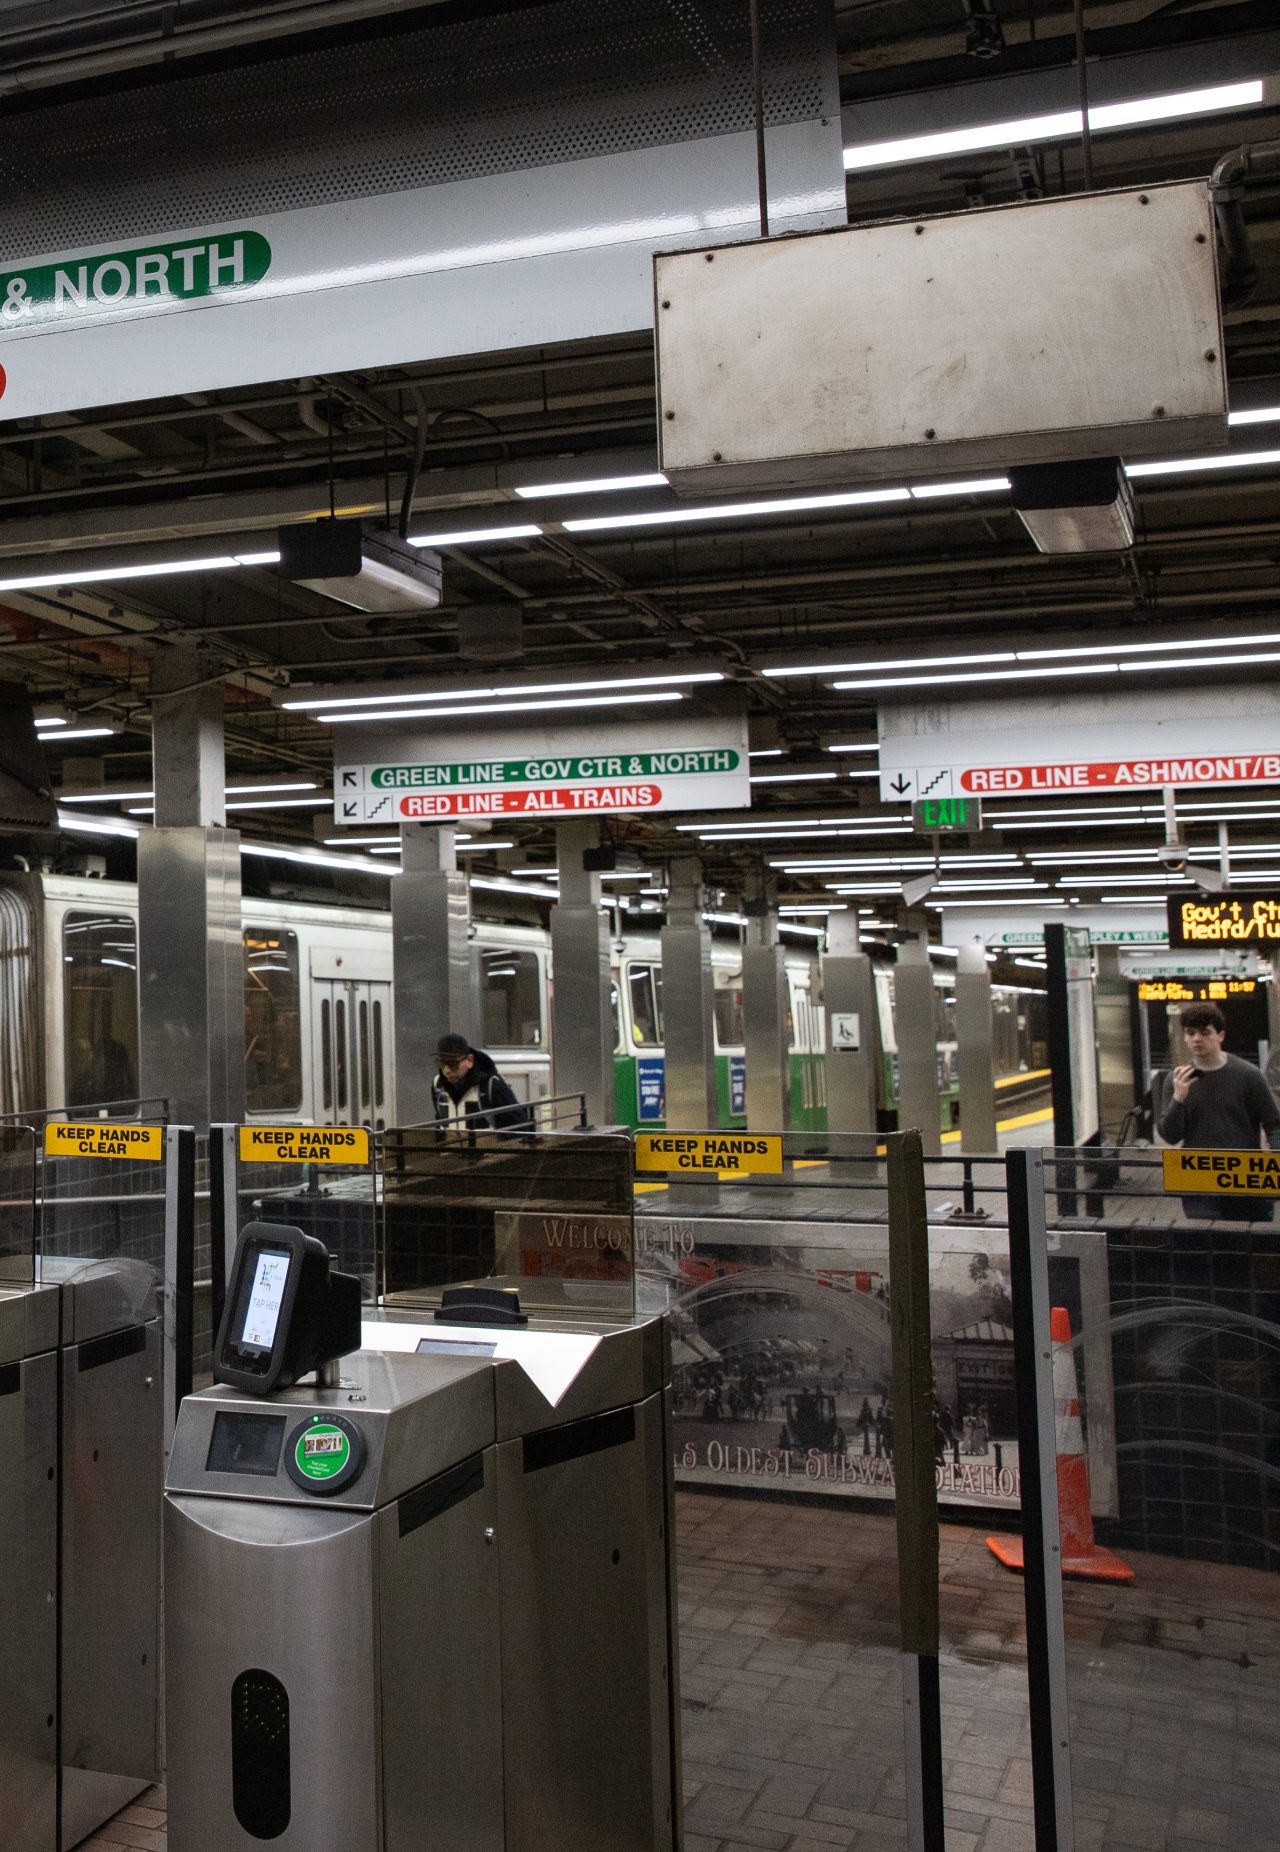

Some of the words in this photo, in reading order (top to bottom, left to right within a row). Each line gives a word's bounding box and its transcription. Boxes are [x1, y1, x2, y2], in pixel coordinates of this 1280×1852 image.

[1, 277, 36, 321] &
[53, 239, 246, 311] NORTH
[379, 766, 452, 787] GREEN
[457, 762, 505, 783] LINE
[524, 759, 572, 781] GOV
[576, 757, 622, 778] CTR
[628, 756, 643, 775] &
[650, 752, 730, 774] NORTH
[970, 769, 1024, 792] RED
[1030, 766, 1089, 789] LINE
[1113, 755, 1280, 785] ASHMONT/B
[407, 795, 451, 816] RED
[456, 792, 504, 813] LINE
[523, 789, 564, 810] ALL
[568, 786, 653, 808] TRAINS
[924, 799, 965, 825] EXIT
[1181, 902, 1243, 921] Gov't
[1252, 900, 1280, 921] Ct
[56, 1126, 96, 1141] KEEP
[98, 1129, 151, 1143] HANDS
[251, 1131, 295, 1146] KEEP
[298, 1132, 356, 1147] HANDS
[77, 1140, 128, 1156] CLEAR
[276, 1145, 331, 1160] CLEAR
[649, 1138, 700, 1153] KEEP
[703, 1139, 769, 1155] HANDS
[676, 1153, 740, 1169] CLEAR
[1180, 1155, 1242, 1171] KEEP
[1216, 1173, 1280, 1189] CLEA
[542, 1219, 654, 1253] WELCOME
[666, 1222, 696, 1254] TO
[266, 1299, 279, 1312] HER
[706, 1439, 795, 1480] OLDEST
[804, 1447, 896, 1487] SUBWA
